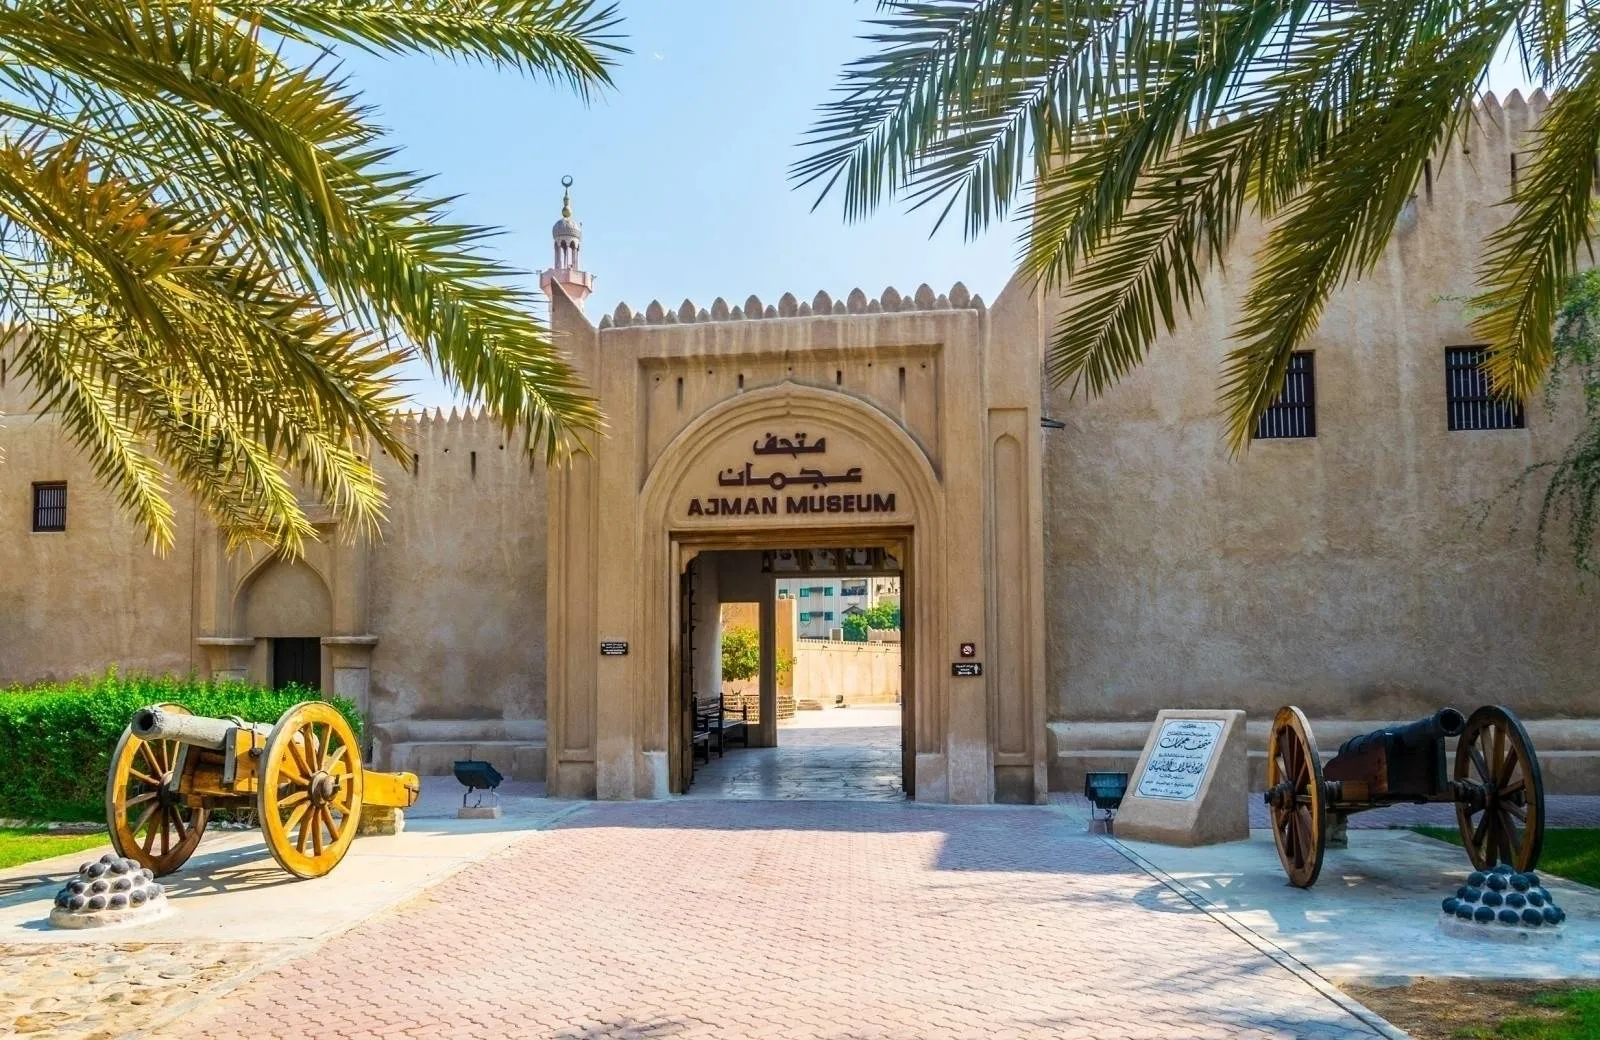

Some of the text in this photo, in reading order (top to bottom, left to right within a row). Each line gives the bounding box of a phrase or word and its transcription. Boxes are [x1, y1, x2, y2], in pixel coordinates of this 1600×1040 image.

[753, 432, 826, 459] متحف
[718, 462, 862, 490] عجمان
[687, 493, 896, 516] AJMAN MUSEUM
